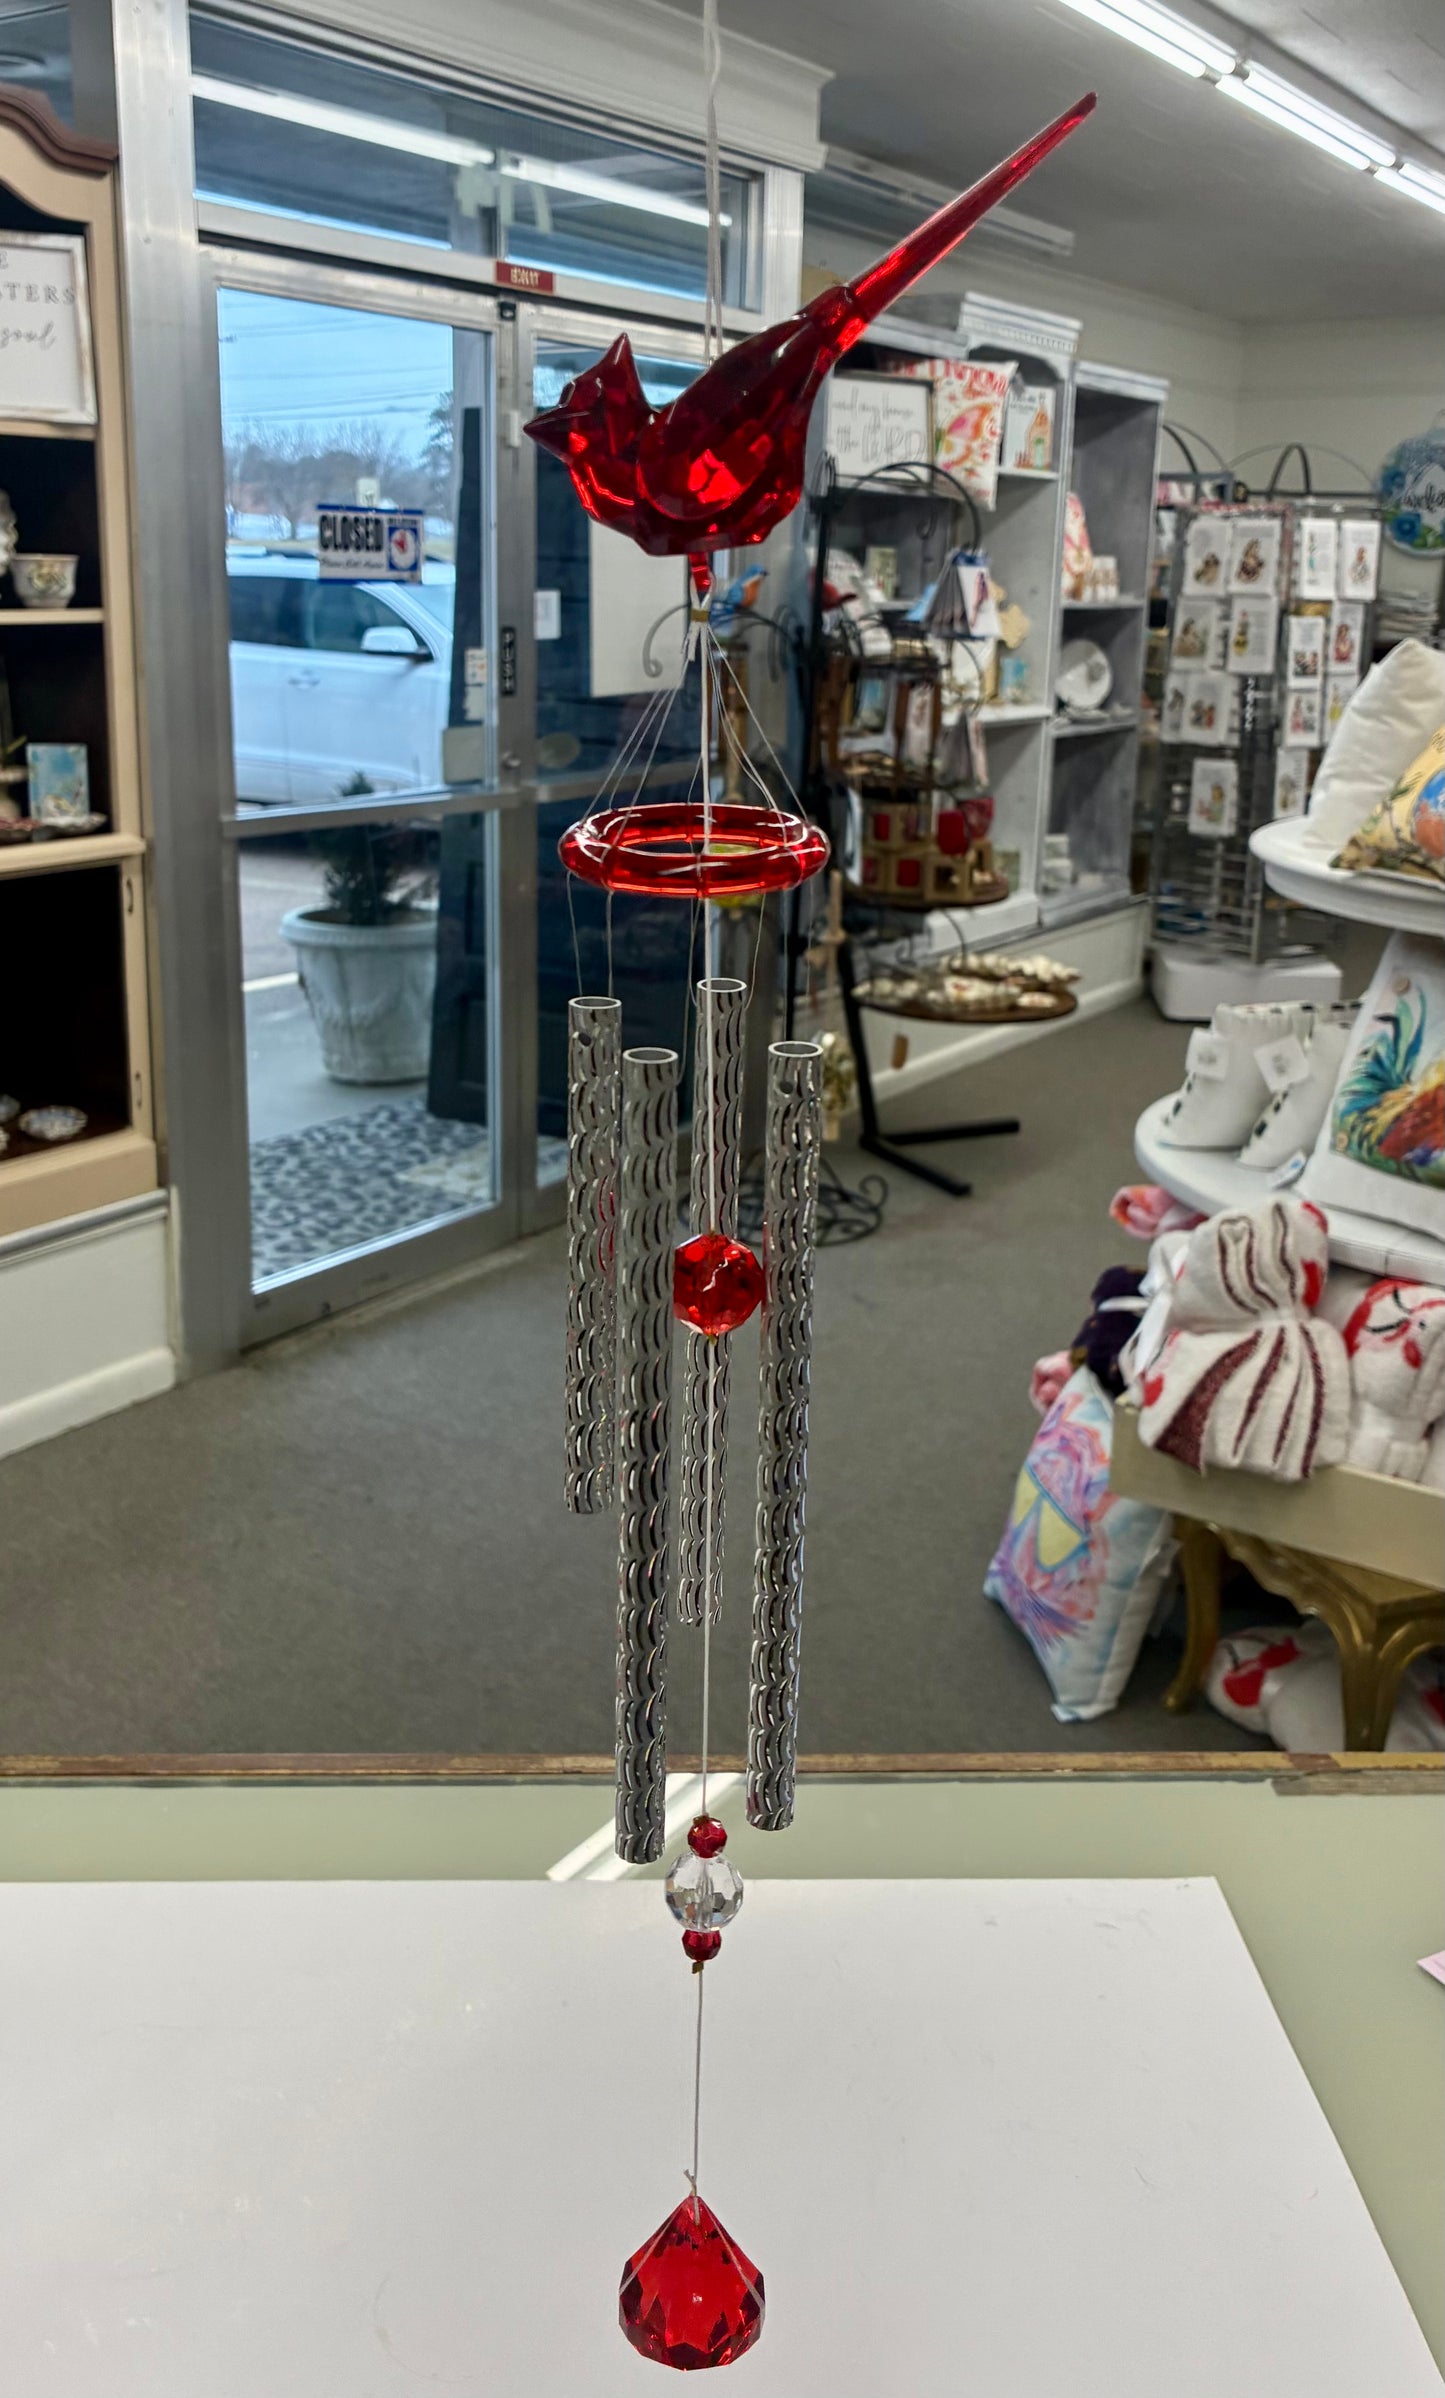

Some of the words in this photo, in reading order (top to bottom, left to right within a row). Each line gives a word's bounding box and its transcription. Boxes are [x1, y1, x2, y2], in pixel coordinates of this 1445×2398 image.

[510, 266, 540, 287] EXIT
[0, 282, 76, 305] TERS
[320, 514, 383, 552] CLOSED
